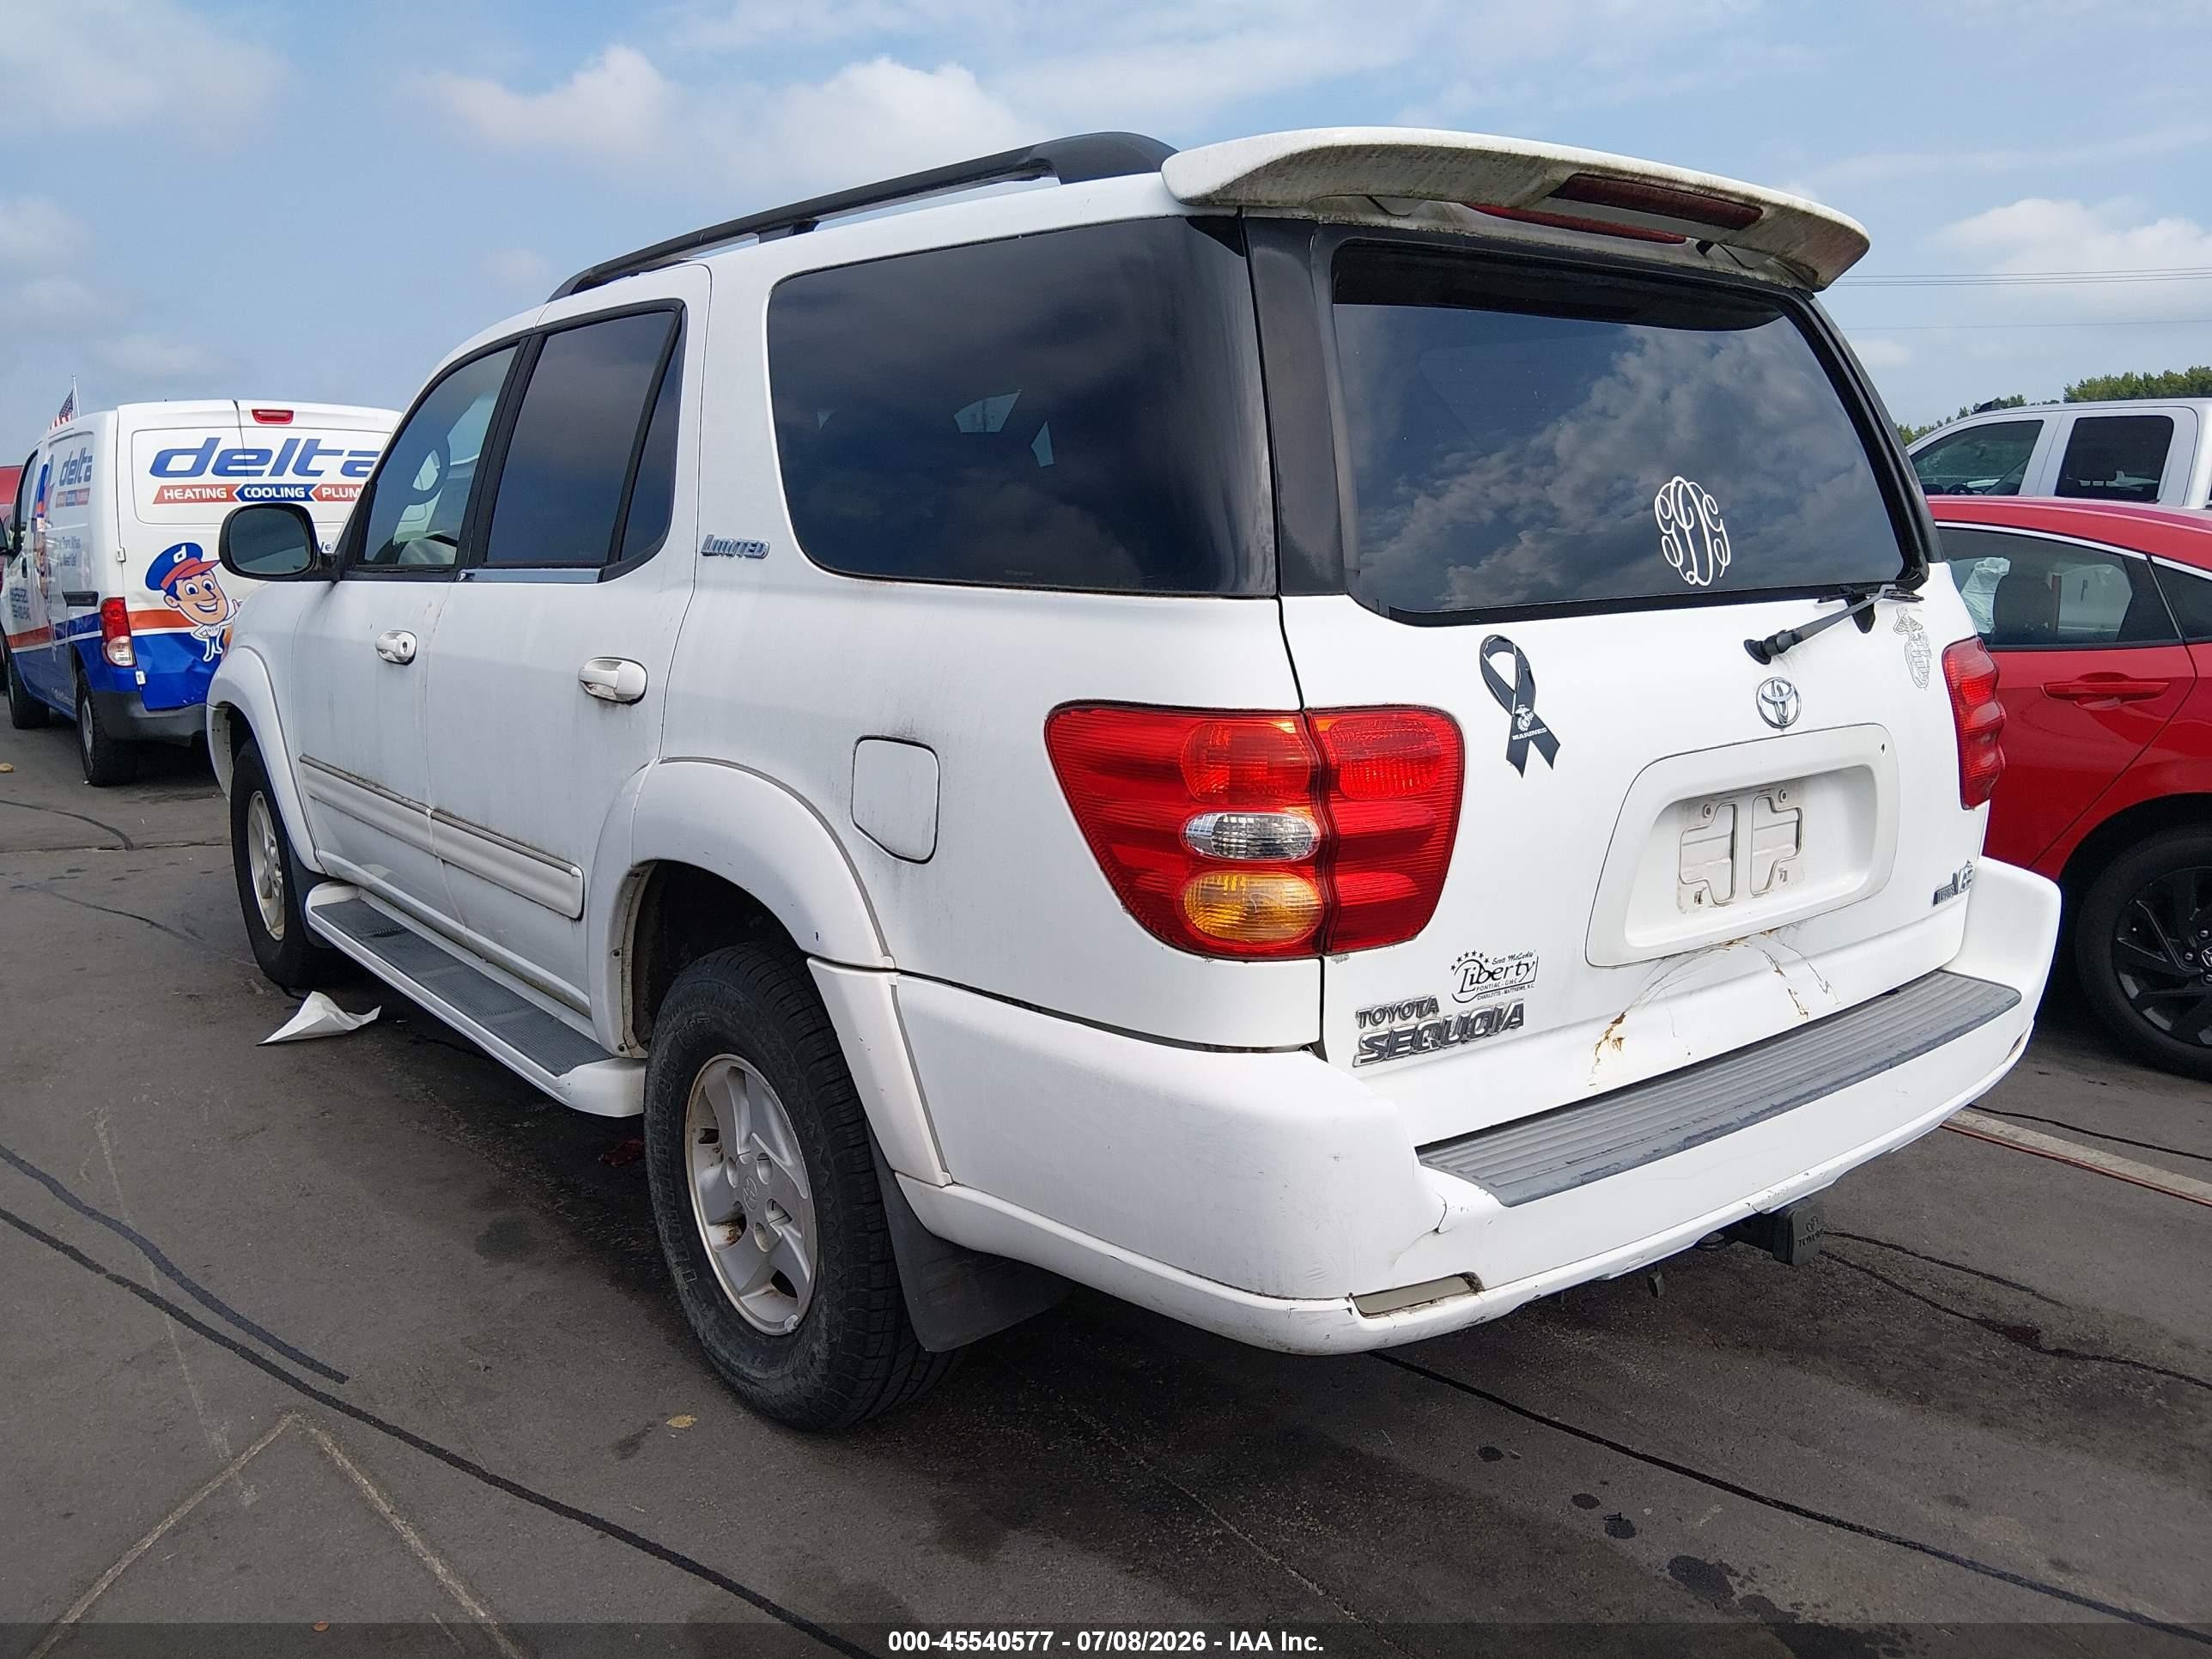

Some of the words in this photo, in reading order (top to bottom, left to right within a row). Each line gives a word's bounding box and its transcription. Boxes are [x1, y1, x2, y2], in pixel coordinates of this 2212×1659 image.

[149, 437, 382, 477] delta
[163, 487, 228, 500] HEATING
[244, 487, 306, 498] COOLING
[1511, 727, 1547, 741] MARINES
[1457, 960, 1535, 994] Liberty
[1476, 981, 1500, 992] PONTIAC
[1355, 995, 1440, 1029] TOYOTA
[1352, 999, 1524, 1067] SEQUOIA
